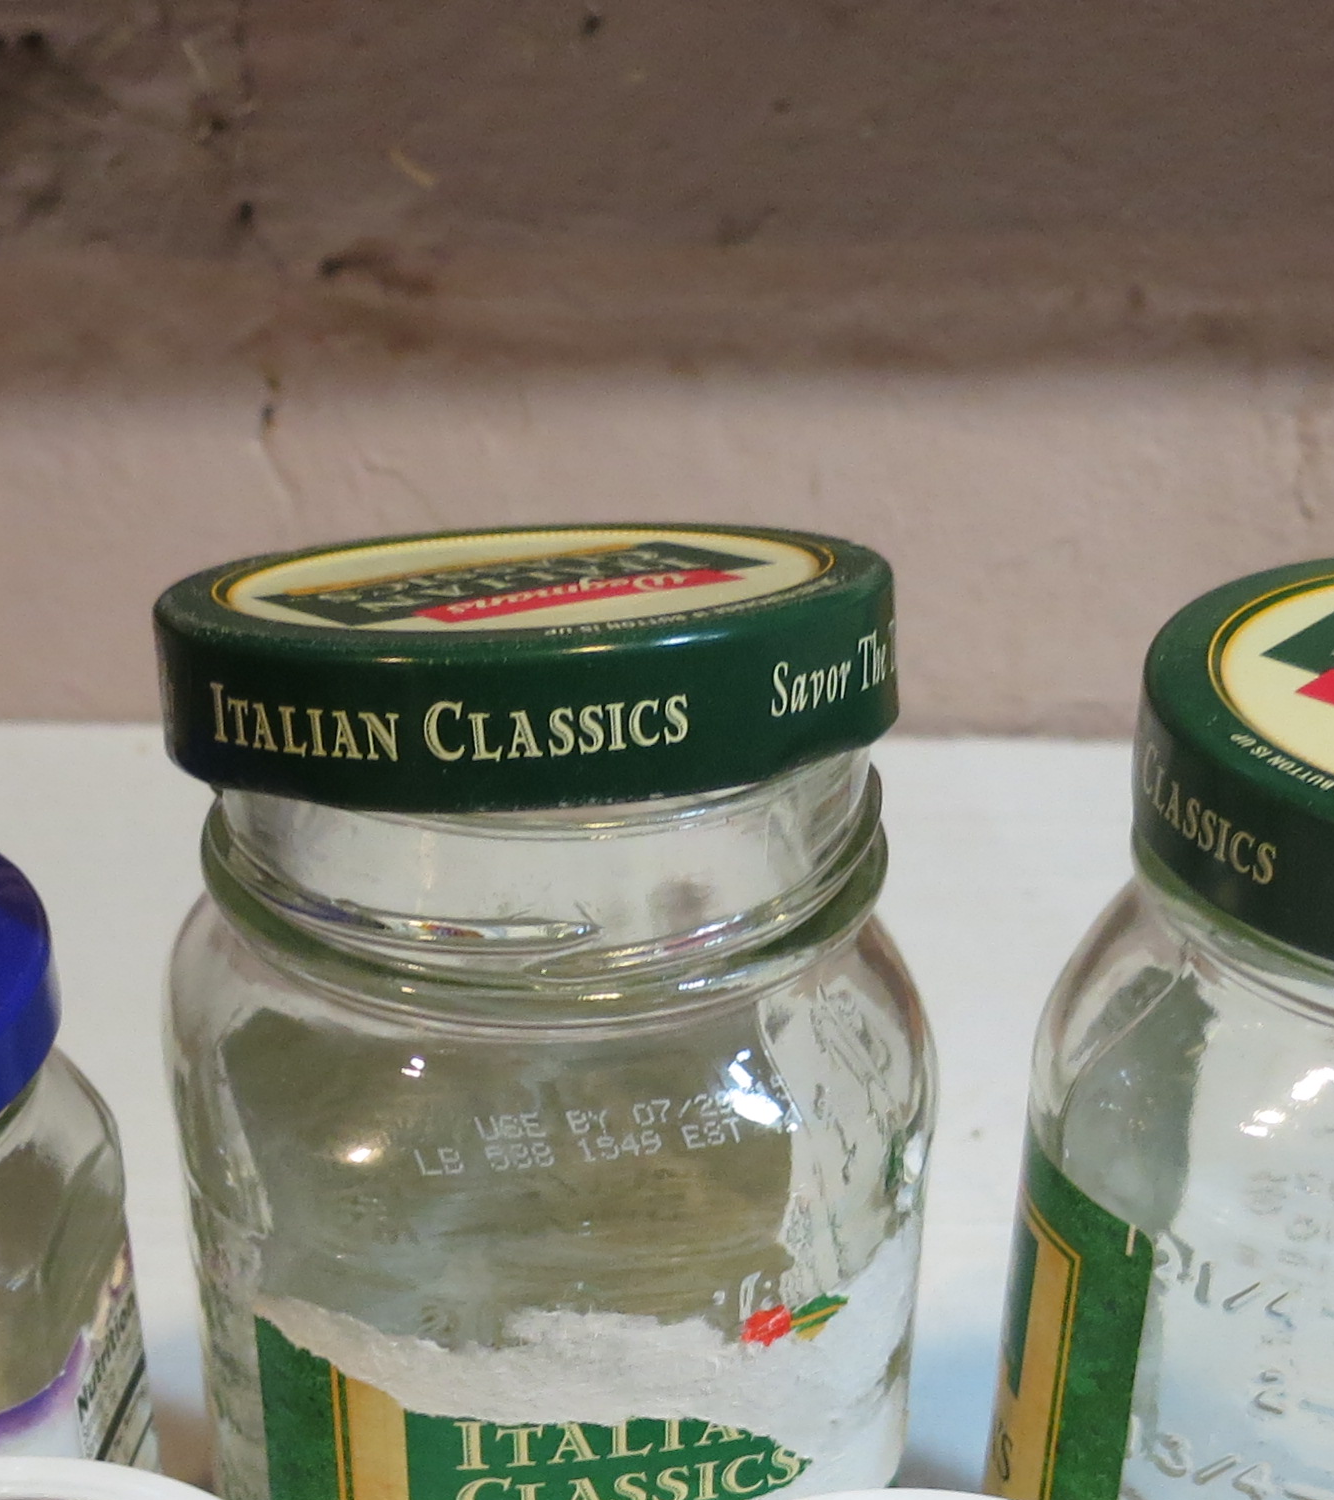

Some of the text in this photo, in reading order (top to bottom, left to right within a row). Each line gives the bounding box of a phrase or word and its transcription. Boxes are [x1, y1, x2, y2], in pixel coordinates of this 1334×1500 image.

[210, 682, 399, 762] ITALIAN
[423, 692, 690, 763] CLASSICS
[770, 660, 852, 719] Savor
[857, 628, 887, 693] The
[1230, 732, 1253, 749] UP
[1250, 746, 1271, 760] IS
[1142, 742, 1278, 886] CLASSICS
[473, 1112, 548, 1141] USE
[453, 1416, 762, 1472] ITALIA
